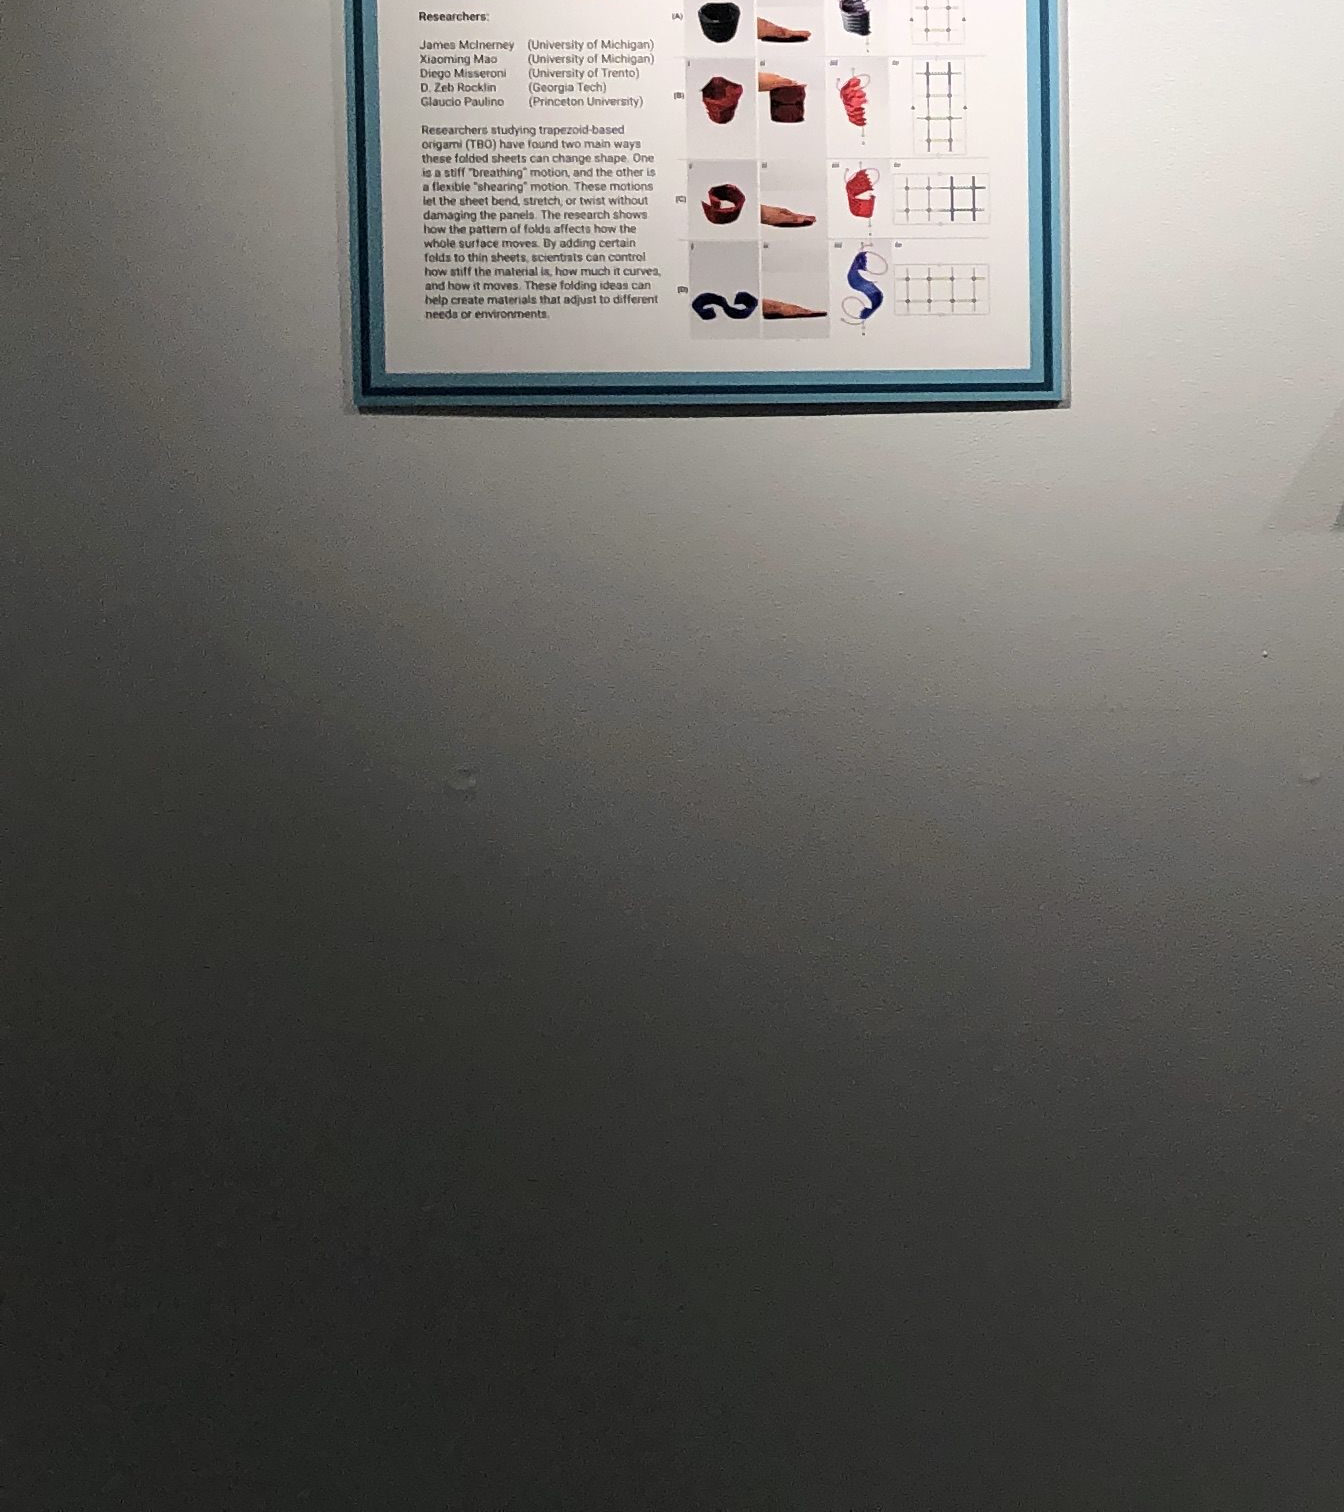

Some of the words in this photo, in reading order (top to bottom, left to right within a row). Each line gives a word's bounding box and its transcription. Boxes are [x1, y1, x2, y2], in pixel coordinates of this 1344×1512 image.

[418, 11, 489, 21] Researchers:
[419, 39, 456, 49] James
[458, 39, 514, 51] McInerney
[527, 38, 584, 52] (University
[586, 39, 598, 49] of
[600, 38, 654, 52] Michigan)
[419, 54, 470, 66] Xiaoming
[473, 54, 497, 63] Mao
[527, 52, 584, 66] (University
[586, 53, 598, 63] of
[601, 52, 654, 66] Michigan)
[419, 68, 451, 80] Diego
[453, 68, 506, 78] Misseroni
[528, 66, 585, 80] (University
[586, 67, 598, 77] of
[600, 66, 639, 80] Trento)
[433, 82, 454, 92] Zeb
[457, 82, 496, 92] Rocklin
[528, 81, 574, 94] (Georgia
[576, 81, 606, 94] Tech)
[420, 96, 461, 106] Glaucio
[463, 96, 504, 106] Paulino
[528, 95, 584, 108] (Princeton
[586, 95, 643, 108] University)
[421, 124, 488, 134] Researchers
[490, 124, 536, 137] studying
[538, 124, 625, 136] trapezoid-based
